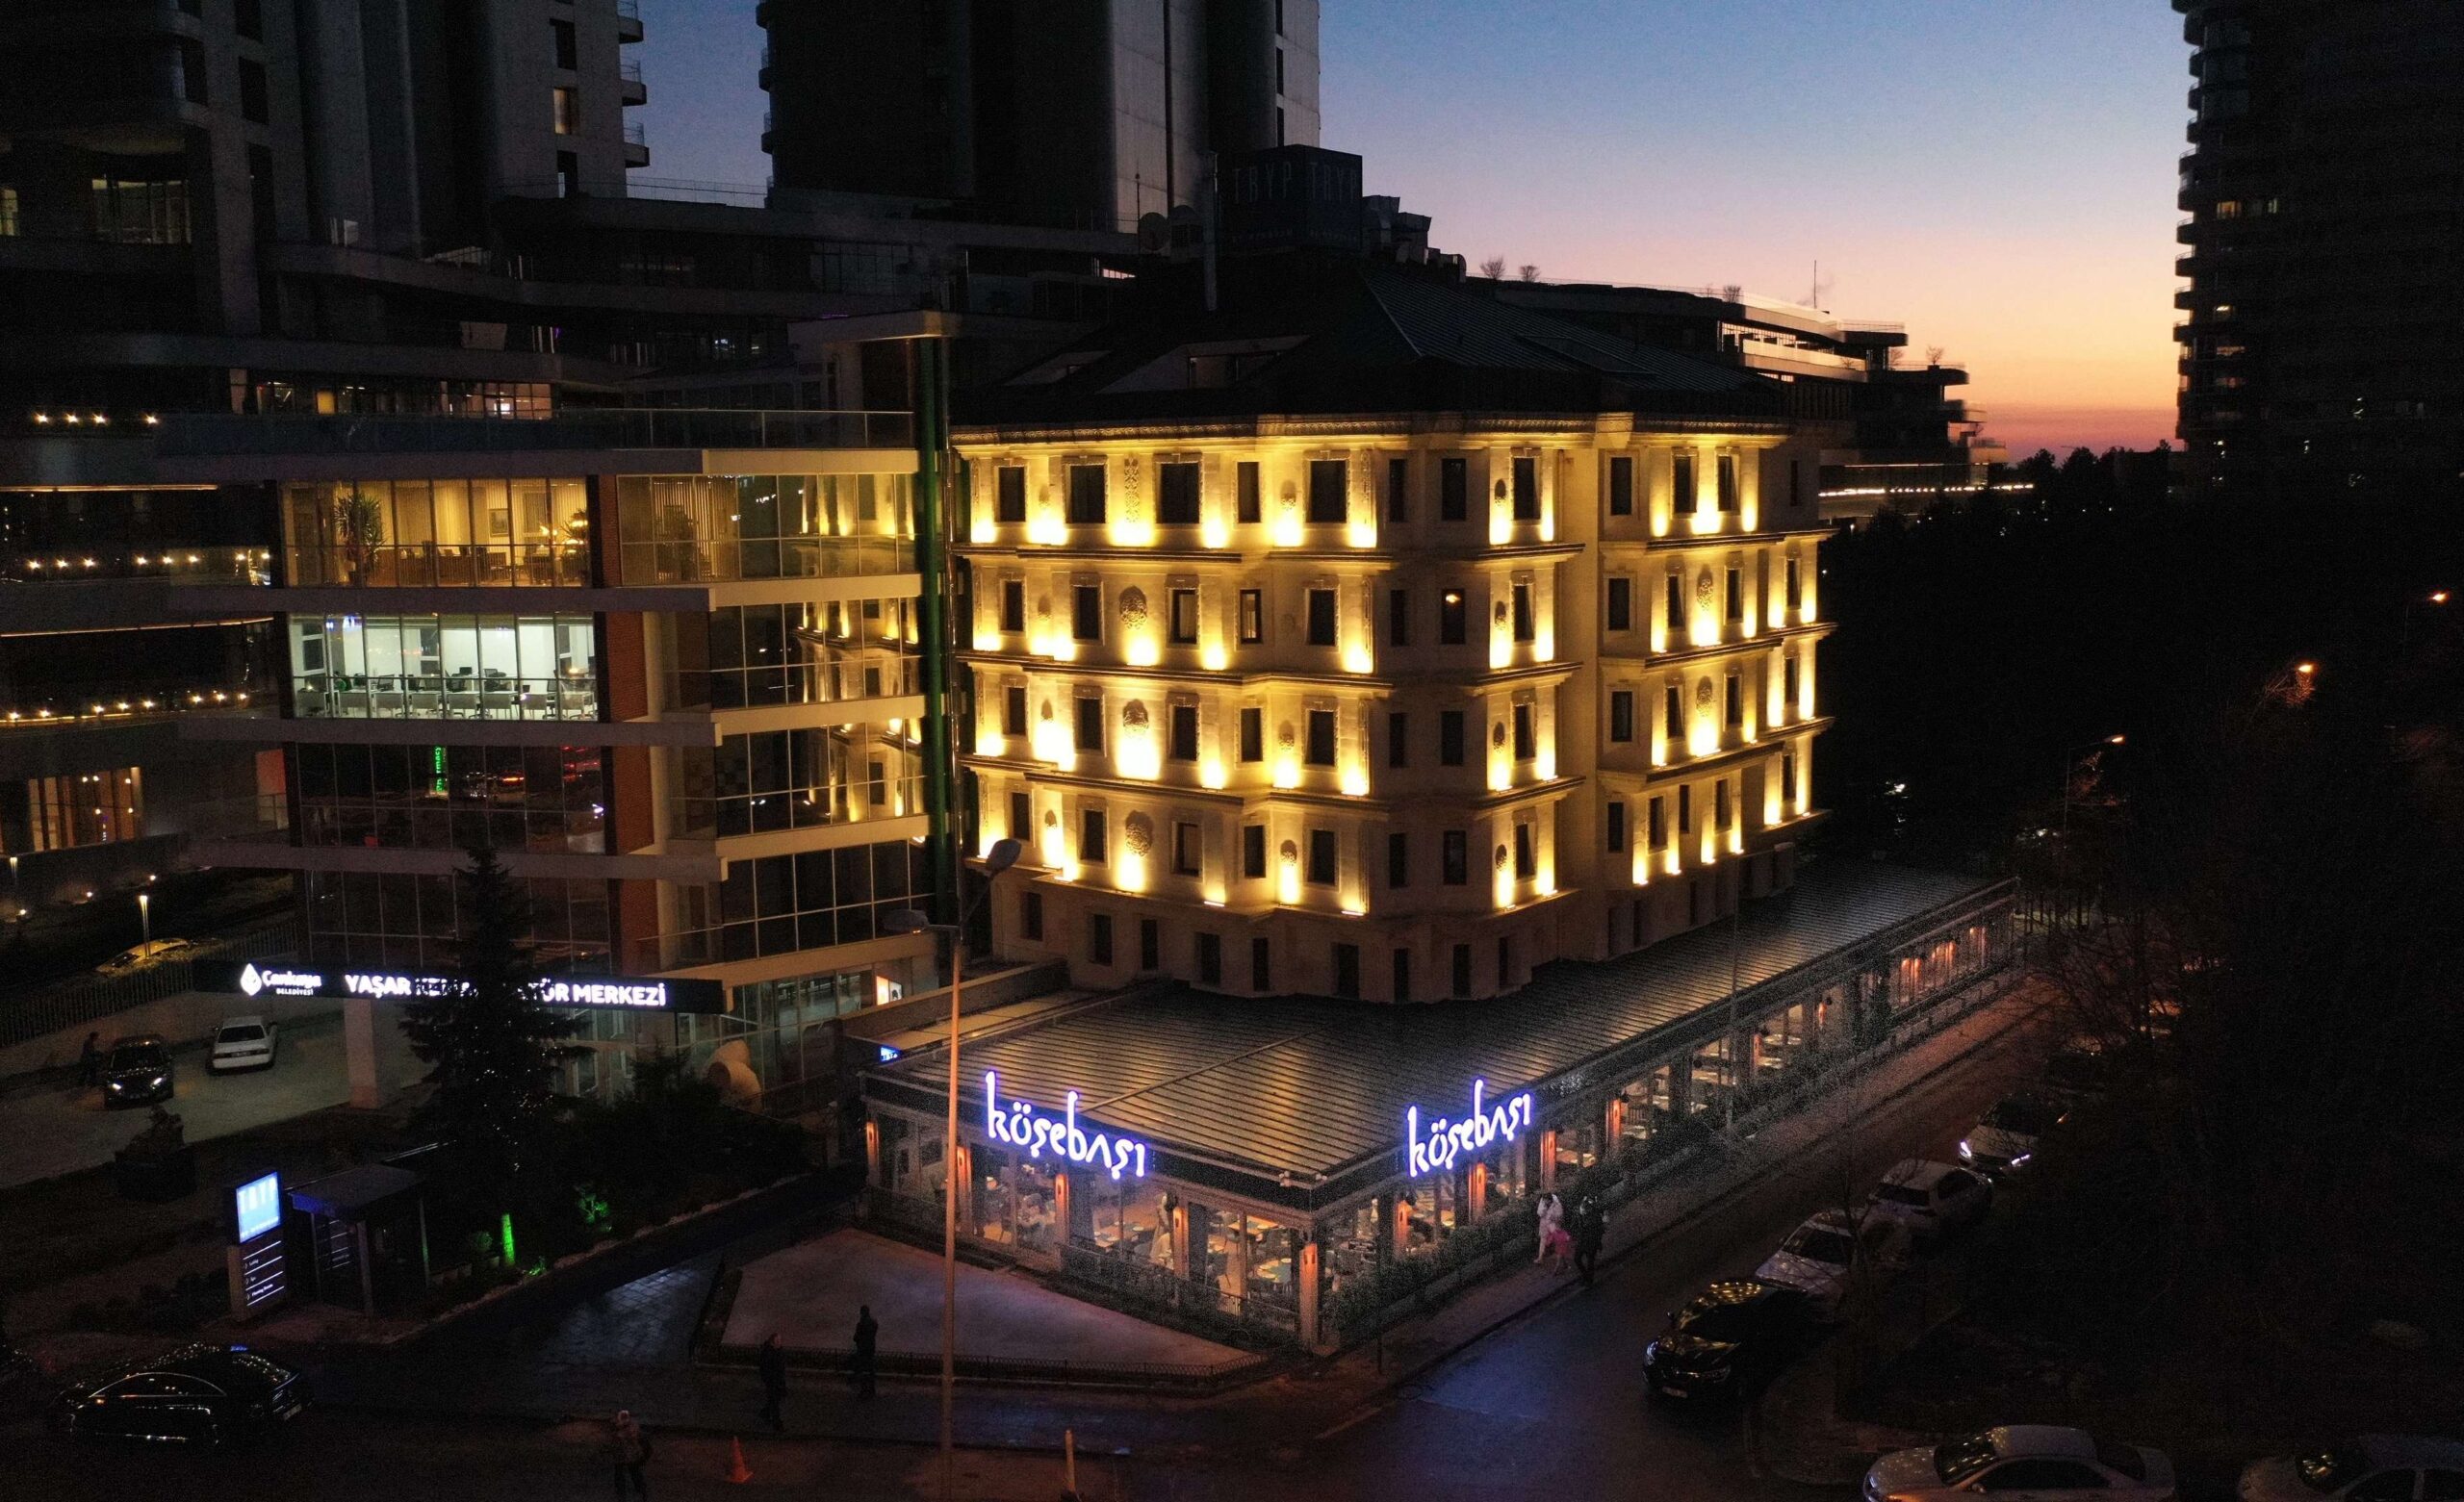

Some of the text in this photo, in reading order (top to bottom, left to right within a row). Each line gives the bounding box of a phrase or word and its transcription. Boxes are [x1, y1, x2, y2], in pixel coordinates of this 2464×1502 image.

[1232, 160, 1292, 204] TRYP
[1309, 161, 1357, 204] TRYP
[344, 974, 412, 999] YAŞAR
[572, 982, 667, 1006] MERKEZİ
[985, 1071, 1145, 1180] köşebaşı
[1407, 1079, 1530, 1178] köşebaşı
